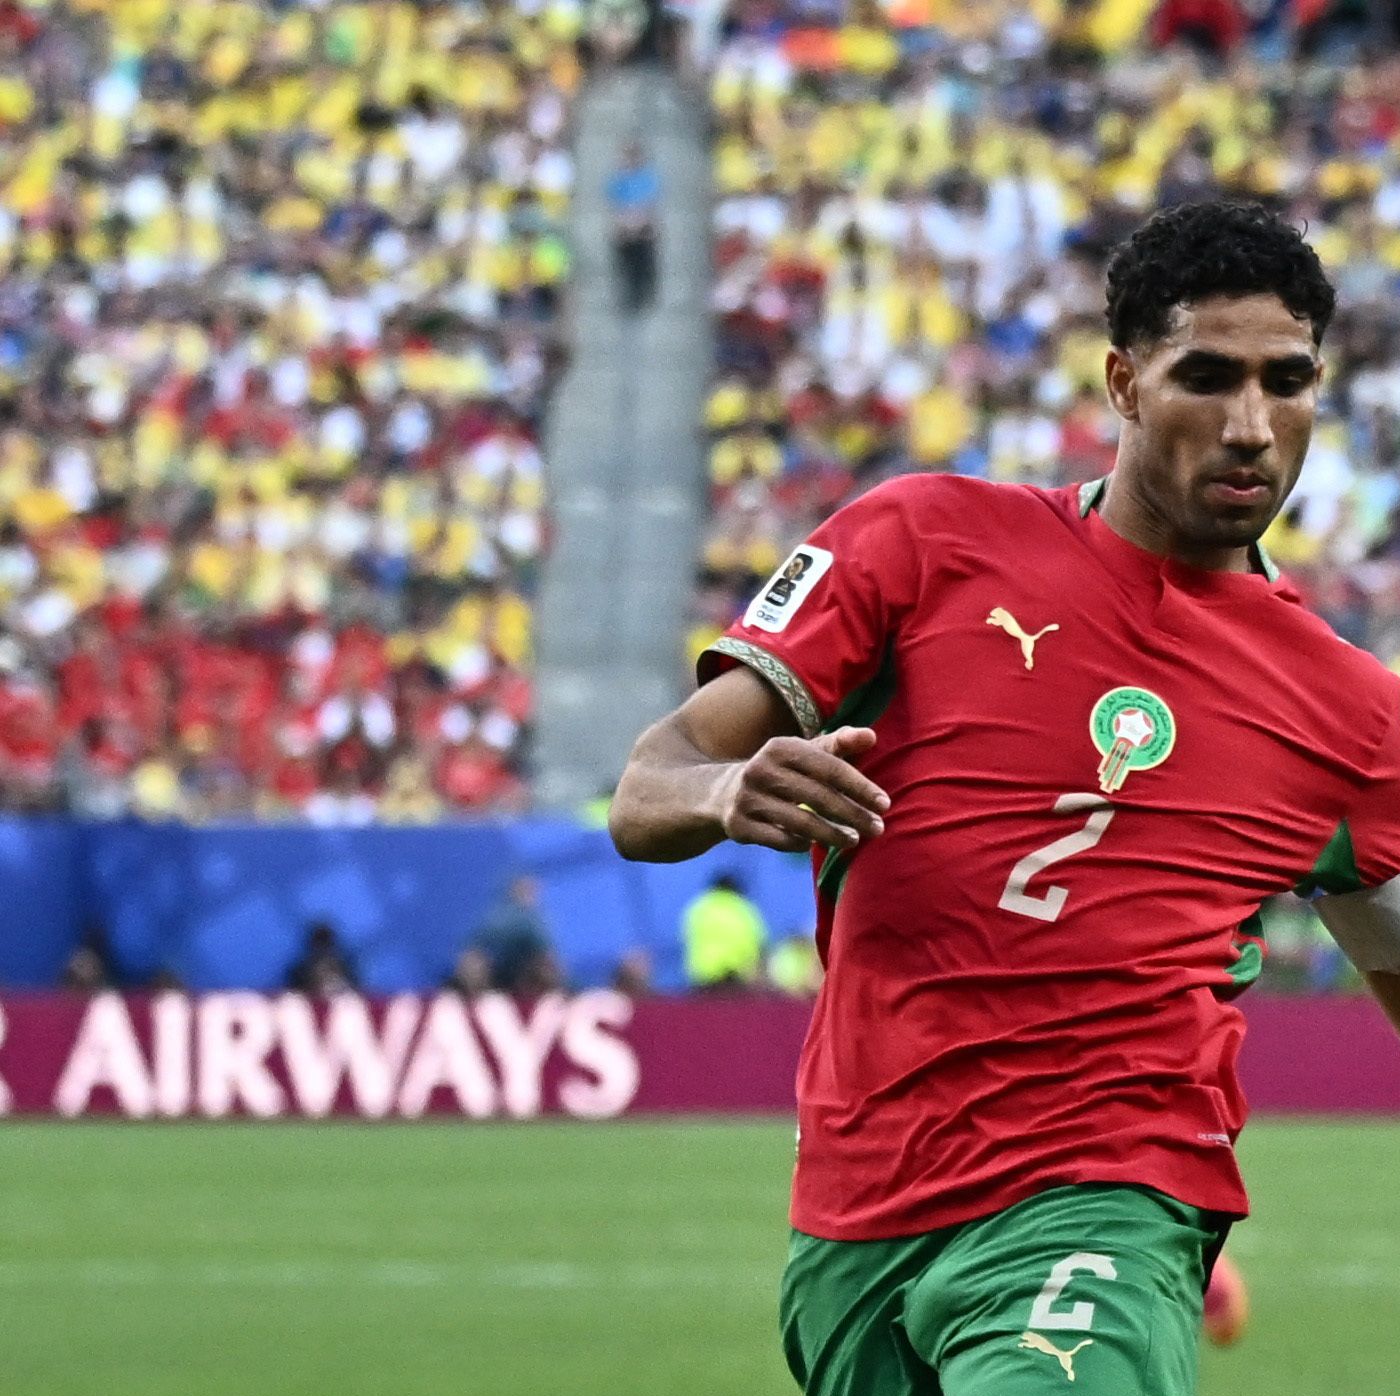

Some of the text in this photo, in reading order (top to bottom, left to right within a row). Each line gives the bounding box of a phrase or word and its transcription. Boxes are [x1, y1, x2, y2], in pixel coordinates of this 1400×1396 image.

[998, 792, 1115, 923] 2
[53, 989, 642, 1120] AIRWAYS
[1027, 1251, 1118, 1331] 2
